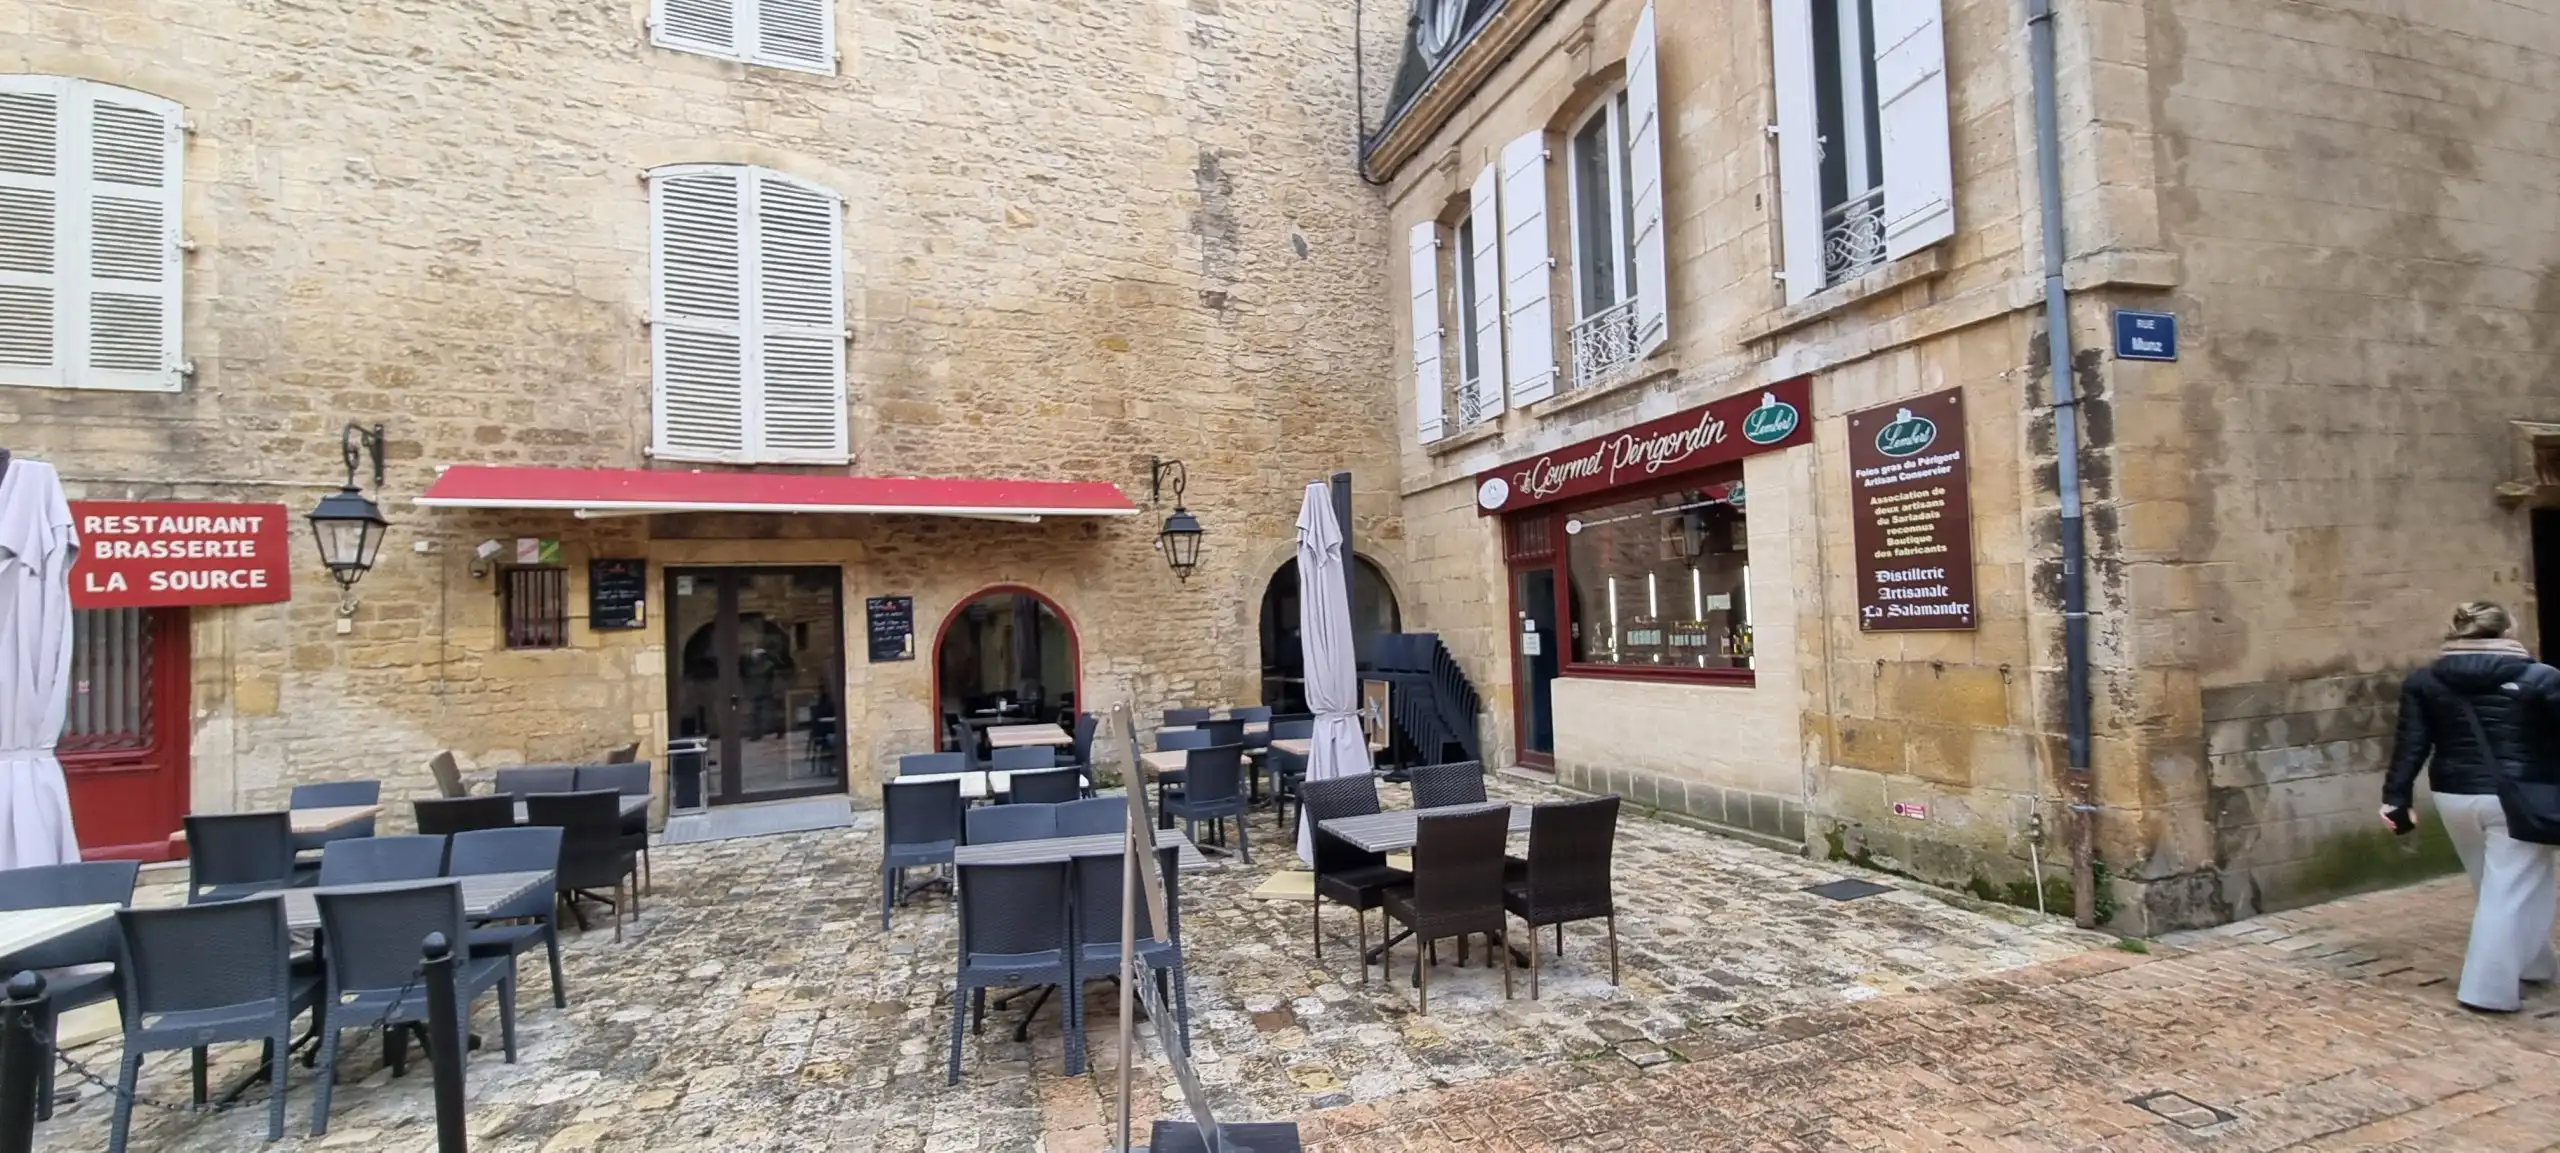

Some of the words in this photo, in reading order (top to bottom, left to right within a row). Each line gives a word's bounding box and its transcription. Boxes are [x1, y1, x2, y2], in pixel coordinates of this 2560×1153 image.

[2136, 319, 2155, 329] RUE
[2132, 336, 2163, 352] Munz
[1531, 441, 1606, 499] Gourmet
[1881, 463, 1902, 475] gras
[1903, 460, 1916, 469] du
[1864, 475, 1898, 487] Artisan
[1870, 490, 1930, 505] Association
[1931, 486, 1946, 496] de
[1874, 506, 1899, 515] deux
[1901, 499, 1945, 512] artisans
[84, 516, 263, 534] RESTAURANT
[1877, 517, 1890, 526] du
[1891, 510, 1941, 524] Sarladais
[1886, 523, 1935, 535] reconnus
[1886, 535, 1933, 546] Boutique
[95, 540, 256, 559] BRASSERIE
[1874, 550, 1893, 559] des
[1894, 545, 1948, 556] fabricants
[85, 572, 129, 592] LA
[149, 569, 268, 591] SOURCE
[1875, 566, 1945, 583] Distillerie
[1877, 584, 1949, 600] Artisanale
[1861, 605, 1883, 618] La
[1887, 601, 1970, 618] Salamandre
